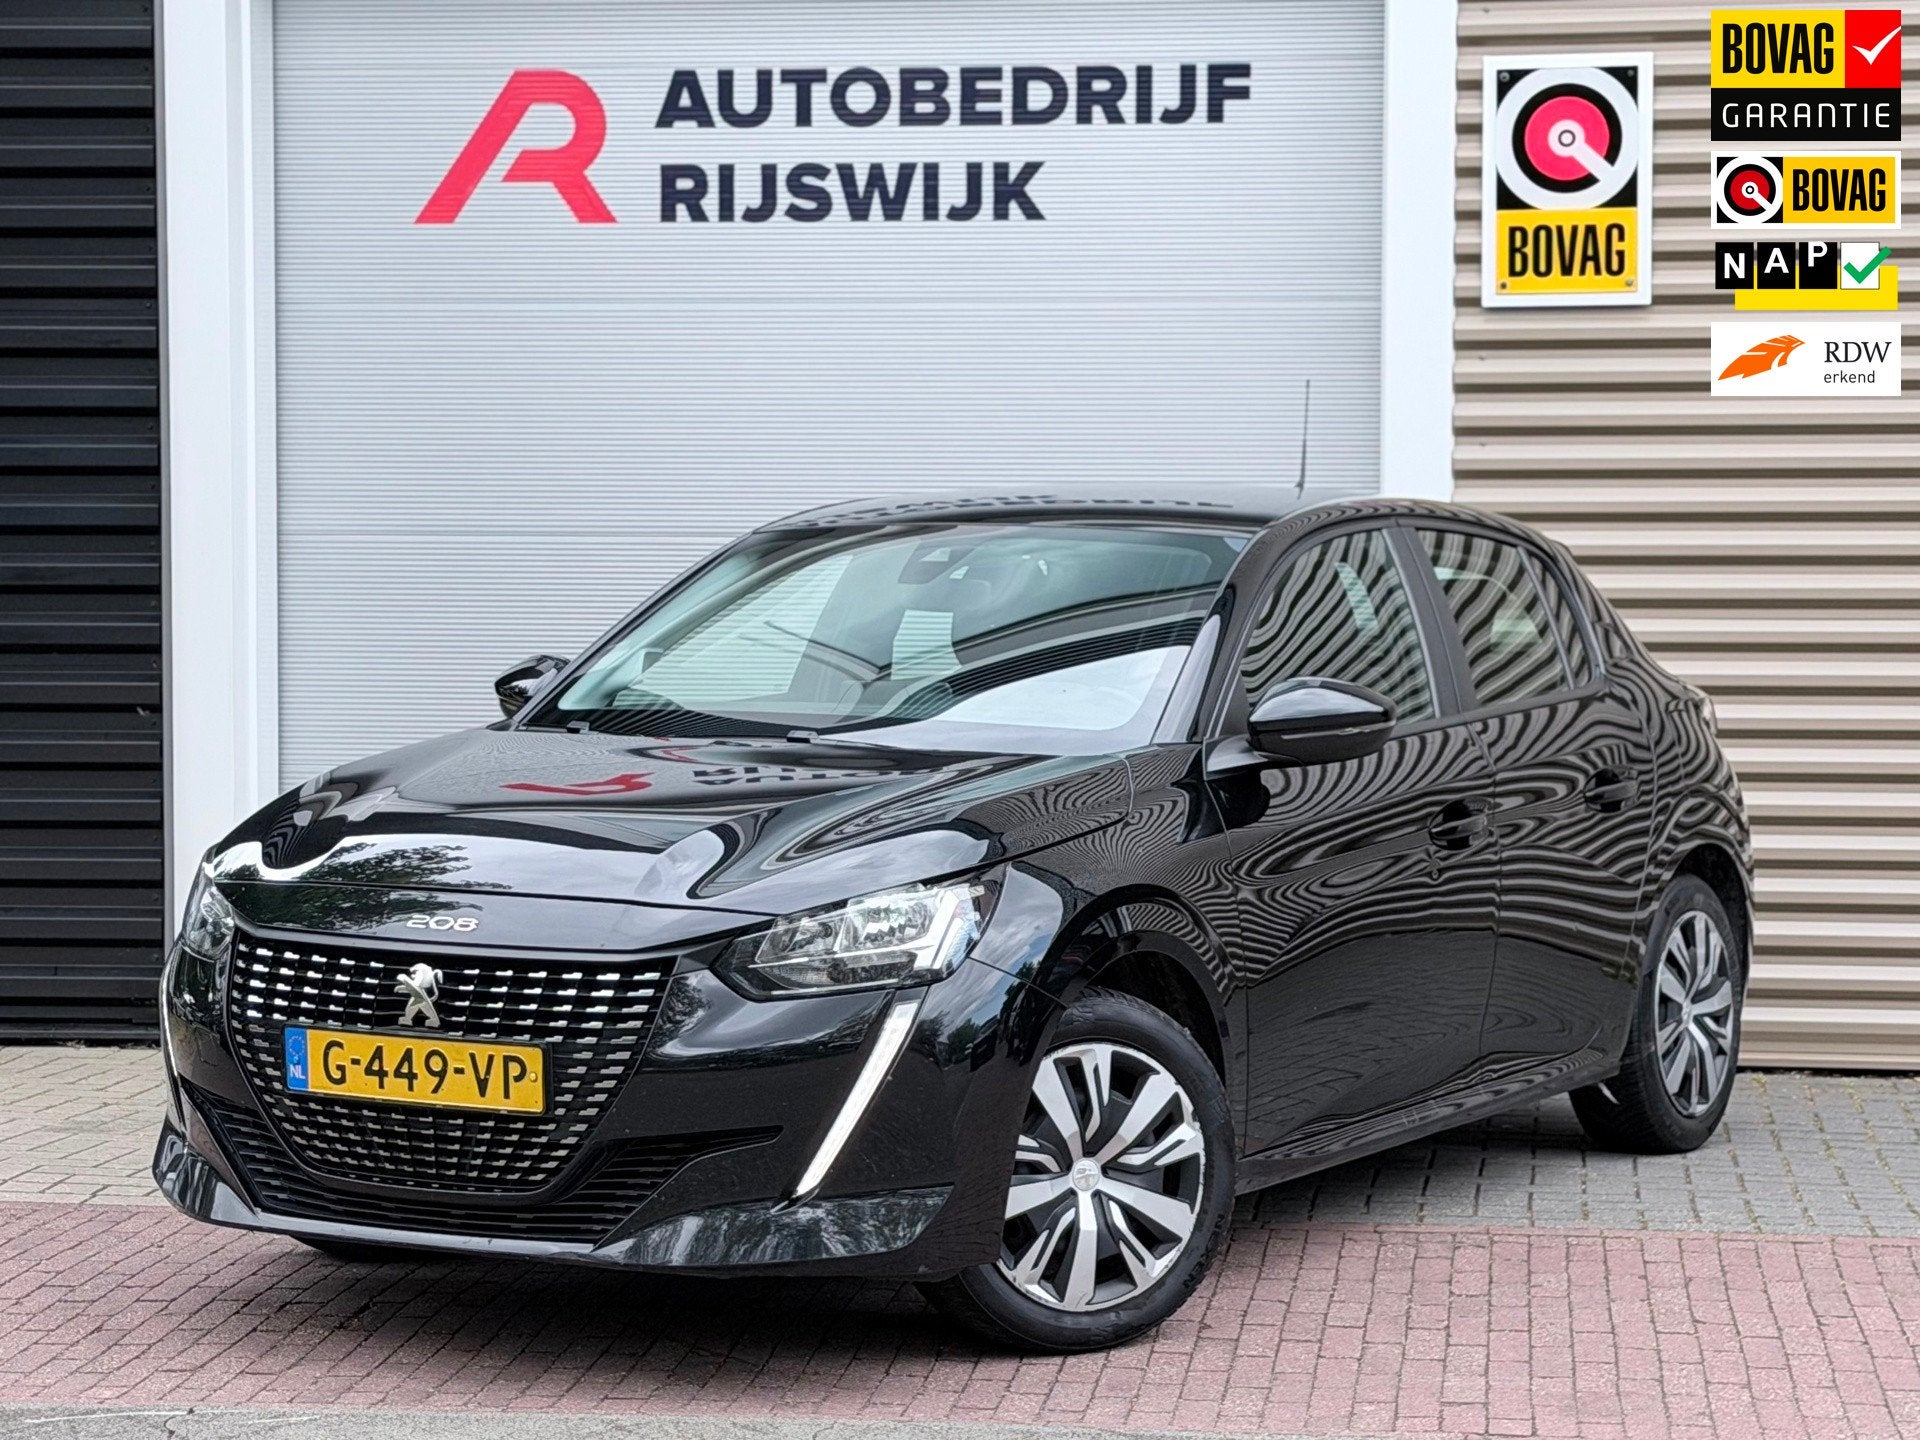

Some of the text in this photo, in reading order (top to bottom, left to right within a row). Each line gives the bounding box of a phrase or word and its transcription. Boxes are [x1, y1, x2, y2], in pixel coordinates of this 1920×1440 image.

[656, 63, 1252, 128] AUTOBEDRIJF
[660, 161, 1046, 224] RIJSWIJK
[1508, 222, 1626, 279] BOVAG
[406, 914, 479, 932] 208
[289, 1063, 307, 1080] NL
[322, 1039, 528, 1100] G-449-VP
